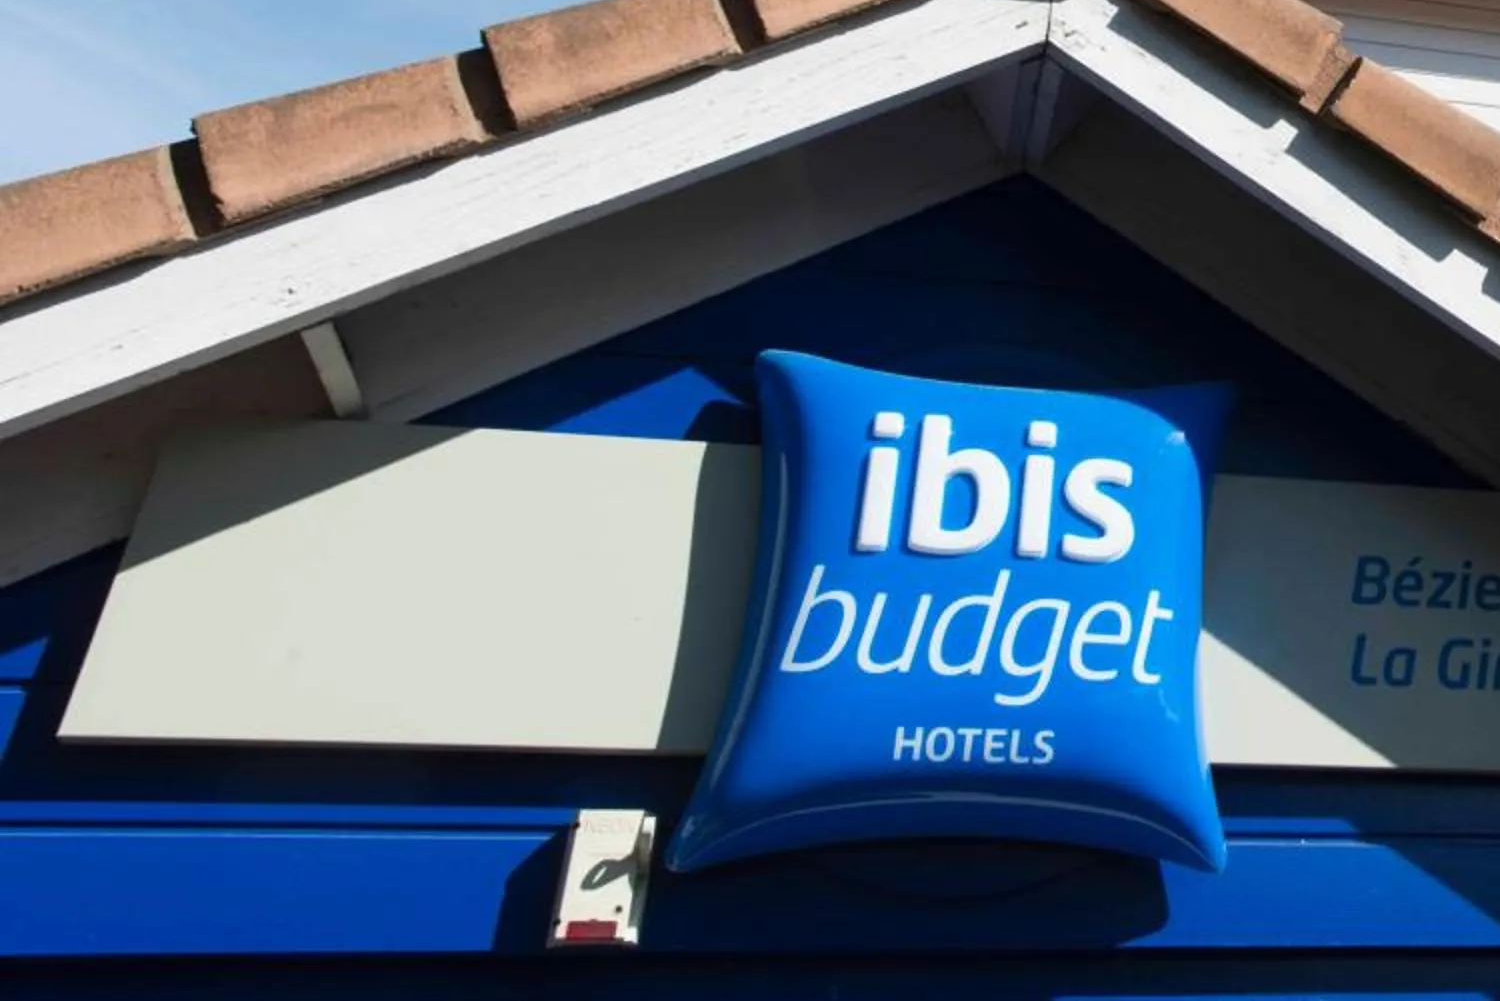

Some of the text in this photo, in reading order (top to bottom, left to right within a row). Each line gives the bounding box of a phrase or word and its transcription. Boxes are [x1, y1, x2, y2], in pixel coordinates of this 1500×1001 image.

[855, 411, 1135, 562] ibis
[780, 564, 1174, 706] budget
[1350, 632, 1418, 688] La
[893, 726, 1056, 765] HOTELS
